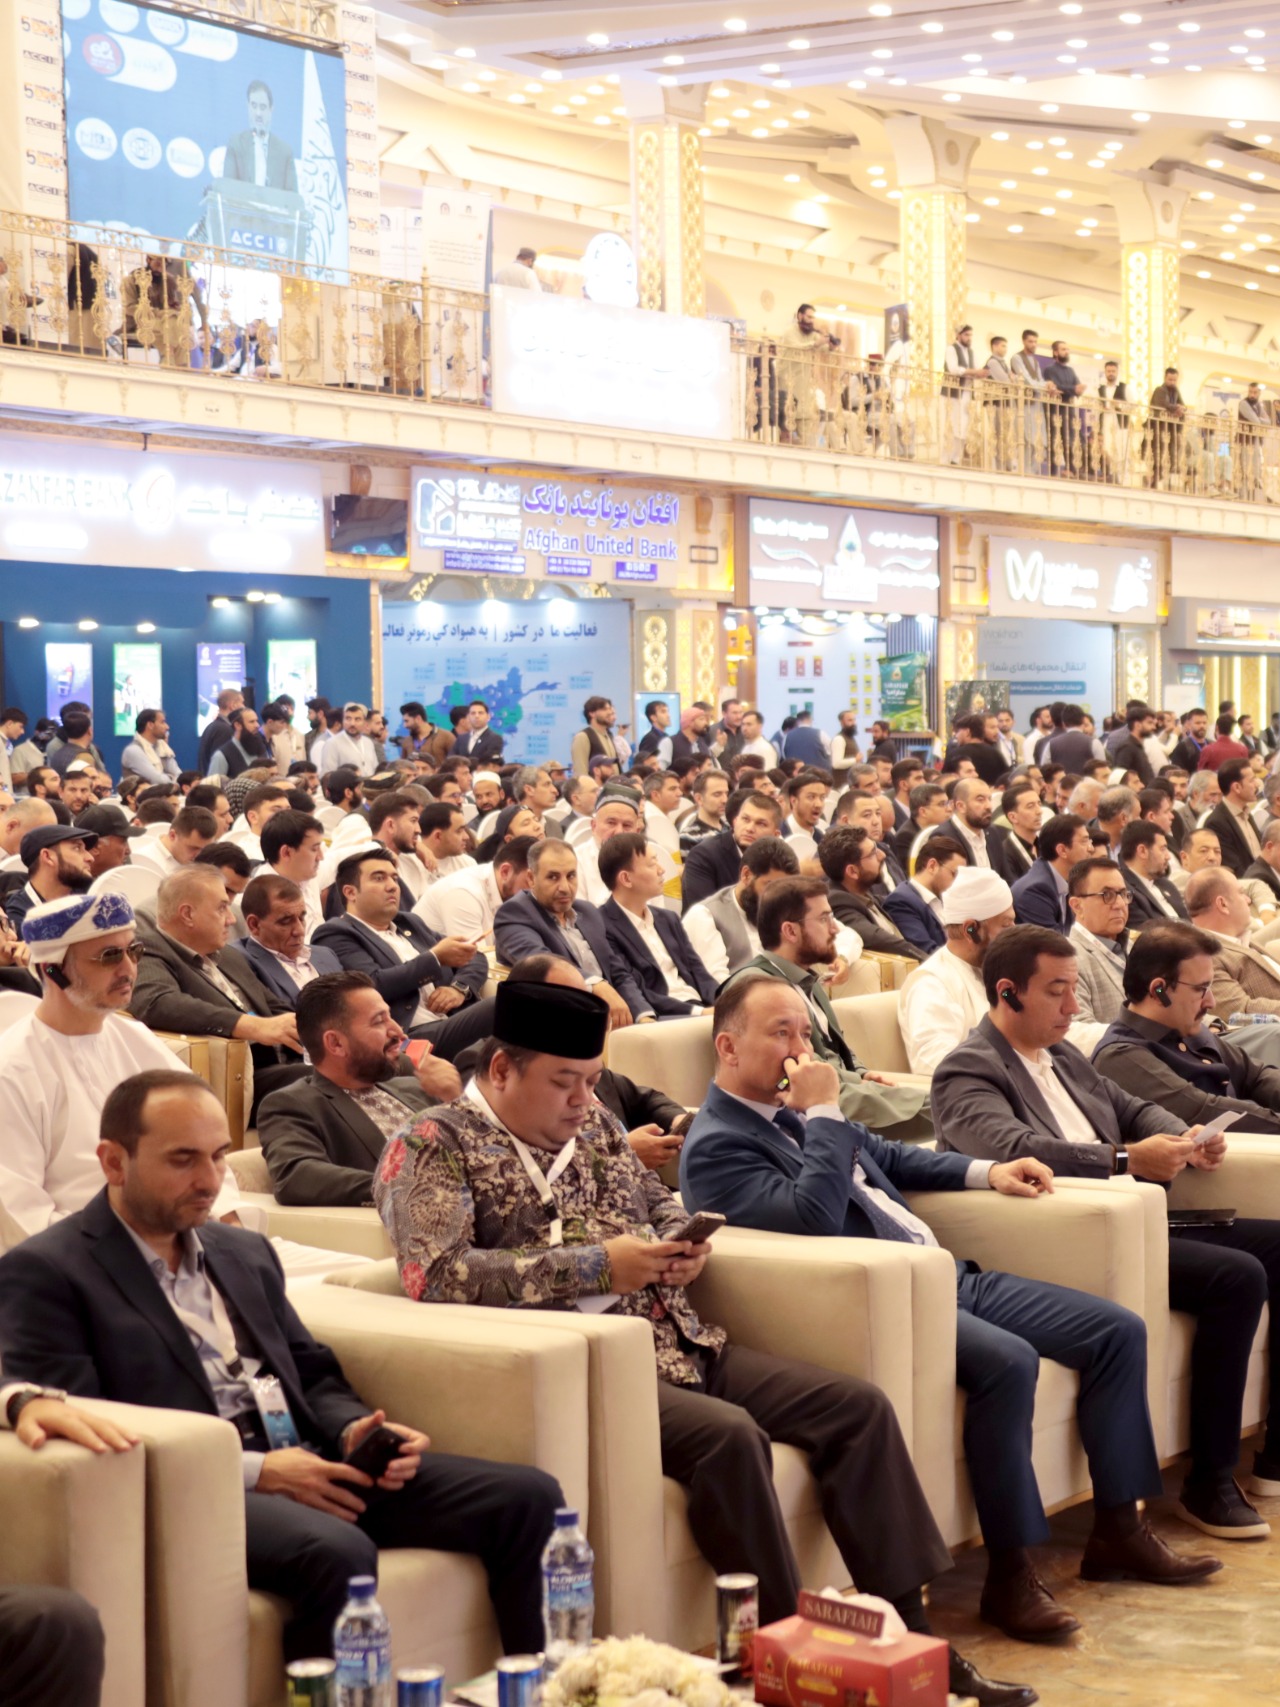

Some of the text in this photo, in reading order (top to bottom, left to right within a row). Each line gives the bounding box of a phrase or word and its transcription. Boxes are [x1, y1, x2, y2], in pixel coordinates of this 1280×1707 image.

[231, 230, 275, 250] ACCI
[0, 472, 77, 507] ZANFAR
[522, 484, 568, 525] بانک
[631, 493, 679, 526] افغان
[524, 528, 580, 554] Afghan
[584, 533, 634, 556] United
[640, 538, 679, 561] Bank
[502, 624, 529, 643] کشور
[562, 622, 598, 641] فعالیت
[804, 1599, 880, 1634] SARAFIAH
